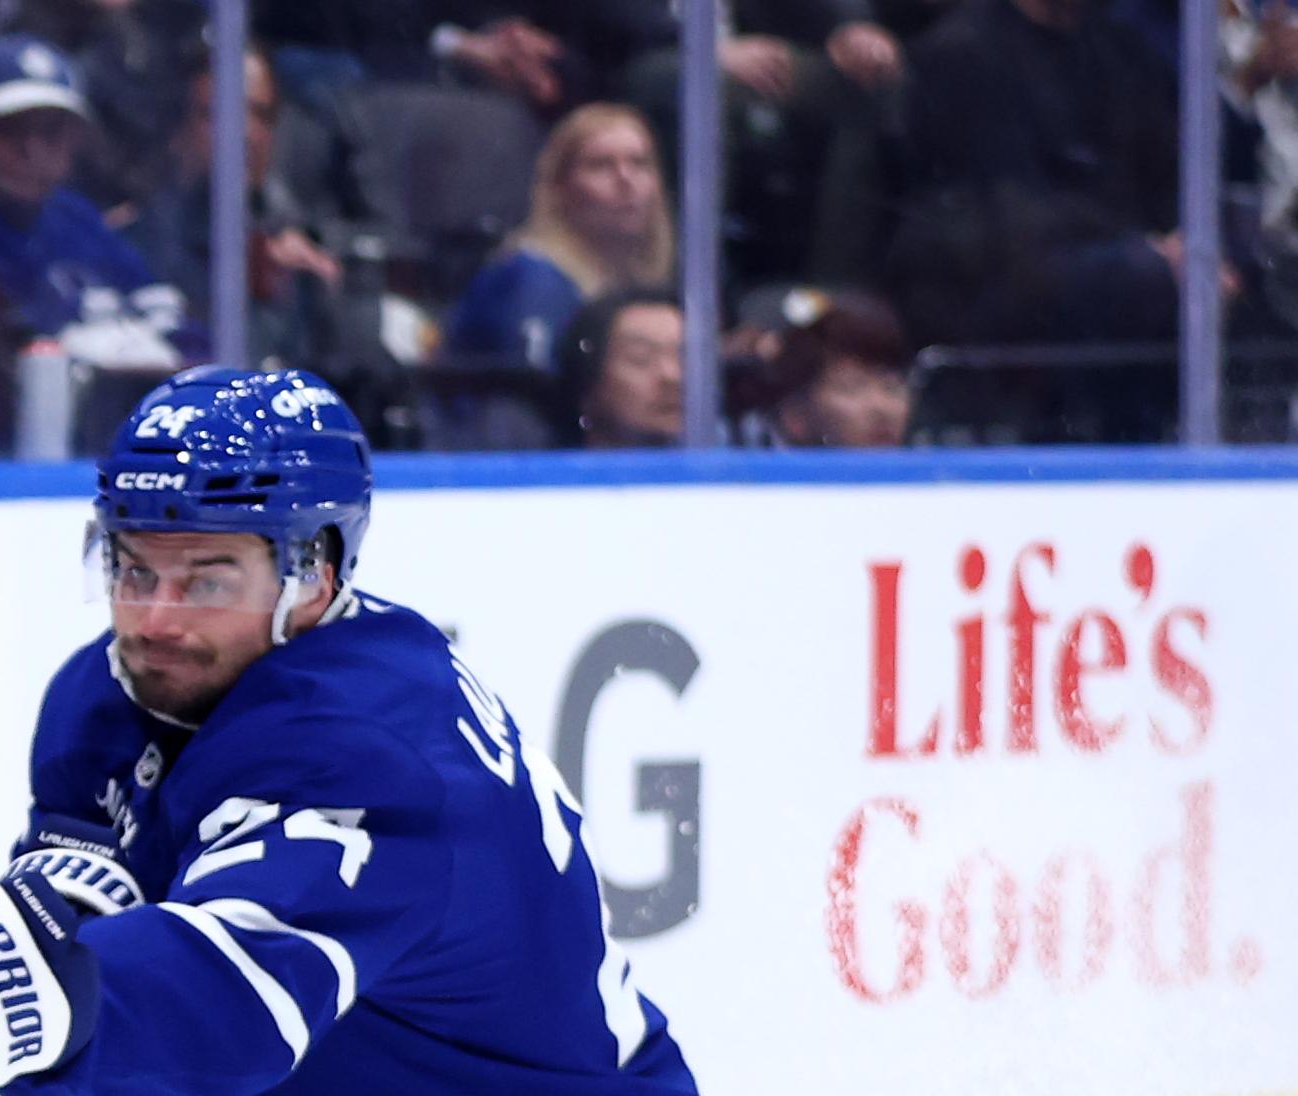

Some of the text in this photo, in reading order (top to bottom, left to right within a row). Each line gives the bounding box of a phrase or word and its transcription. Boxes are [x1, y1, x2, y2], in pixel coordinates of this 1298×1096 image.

[115, 472, 187, 491] CCM
[135, 405, 199, 439] 24
[863, 538, 1217, 760] Life's
[823, 778, 1265, 1003] Good.
